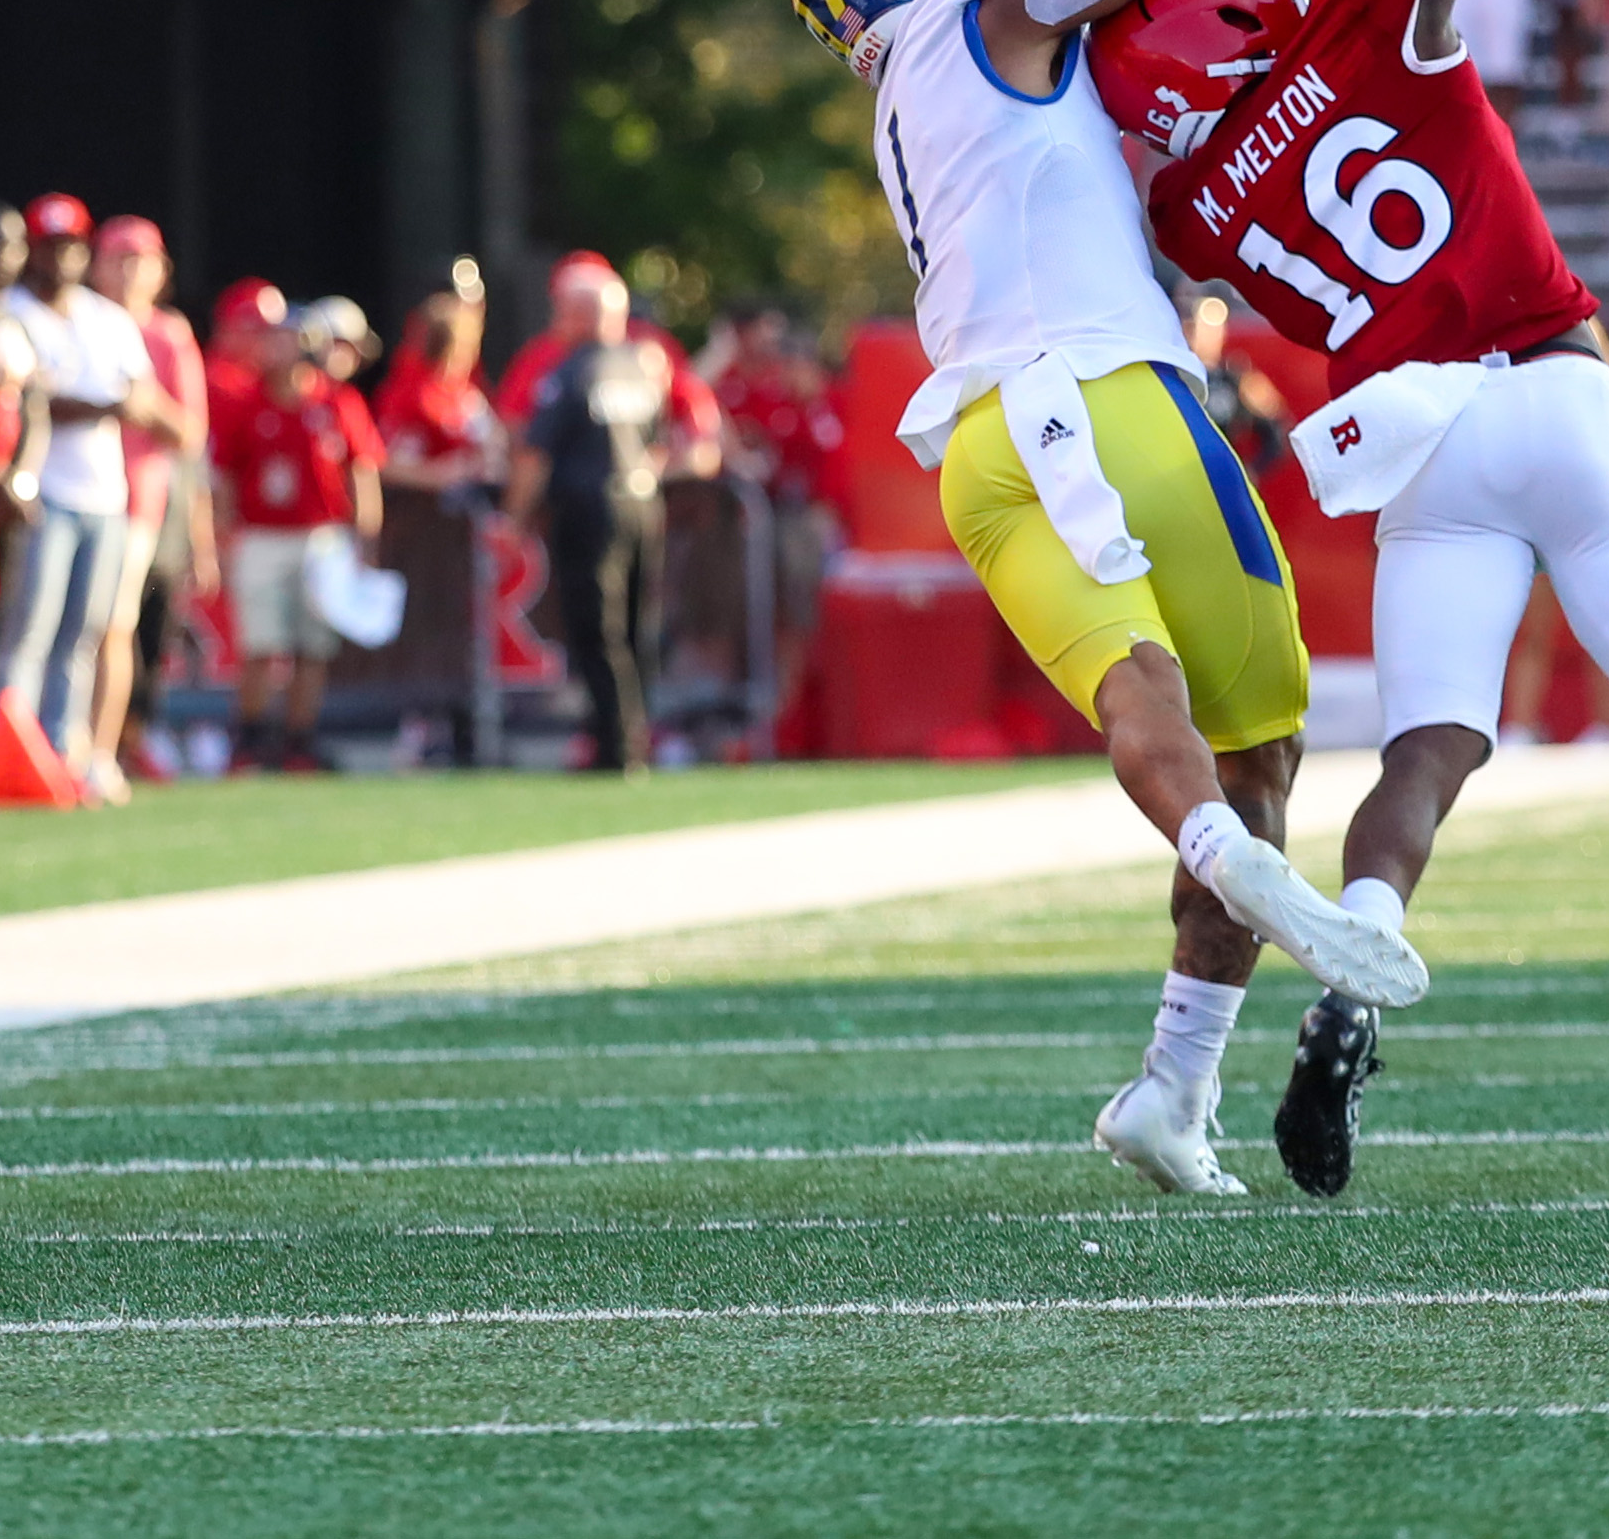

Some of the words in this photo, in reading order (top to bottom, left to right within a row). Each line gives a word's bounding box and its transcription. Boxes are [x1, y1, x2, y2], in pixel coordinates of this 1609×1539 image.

[1142, 109, 1174, 145] 16
[1192, 185, 1235, 237] M.
[1222, 63, 1338, 198] MELTON
[1237, 115, 1454, 353] 16
[1330, 415, 1361, 456] R
